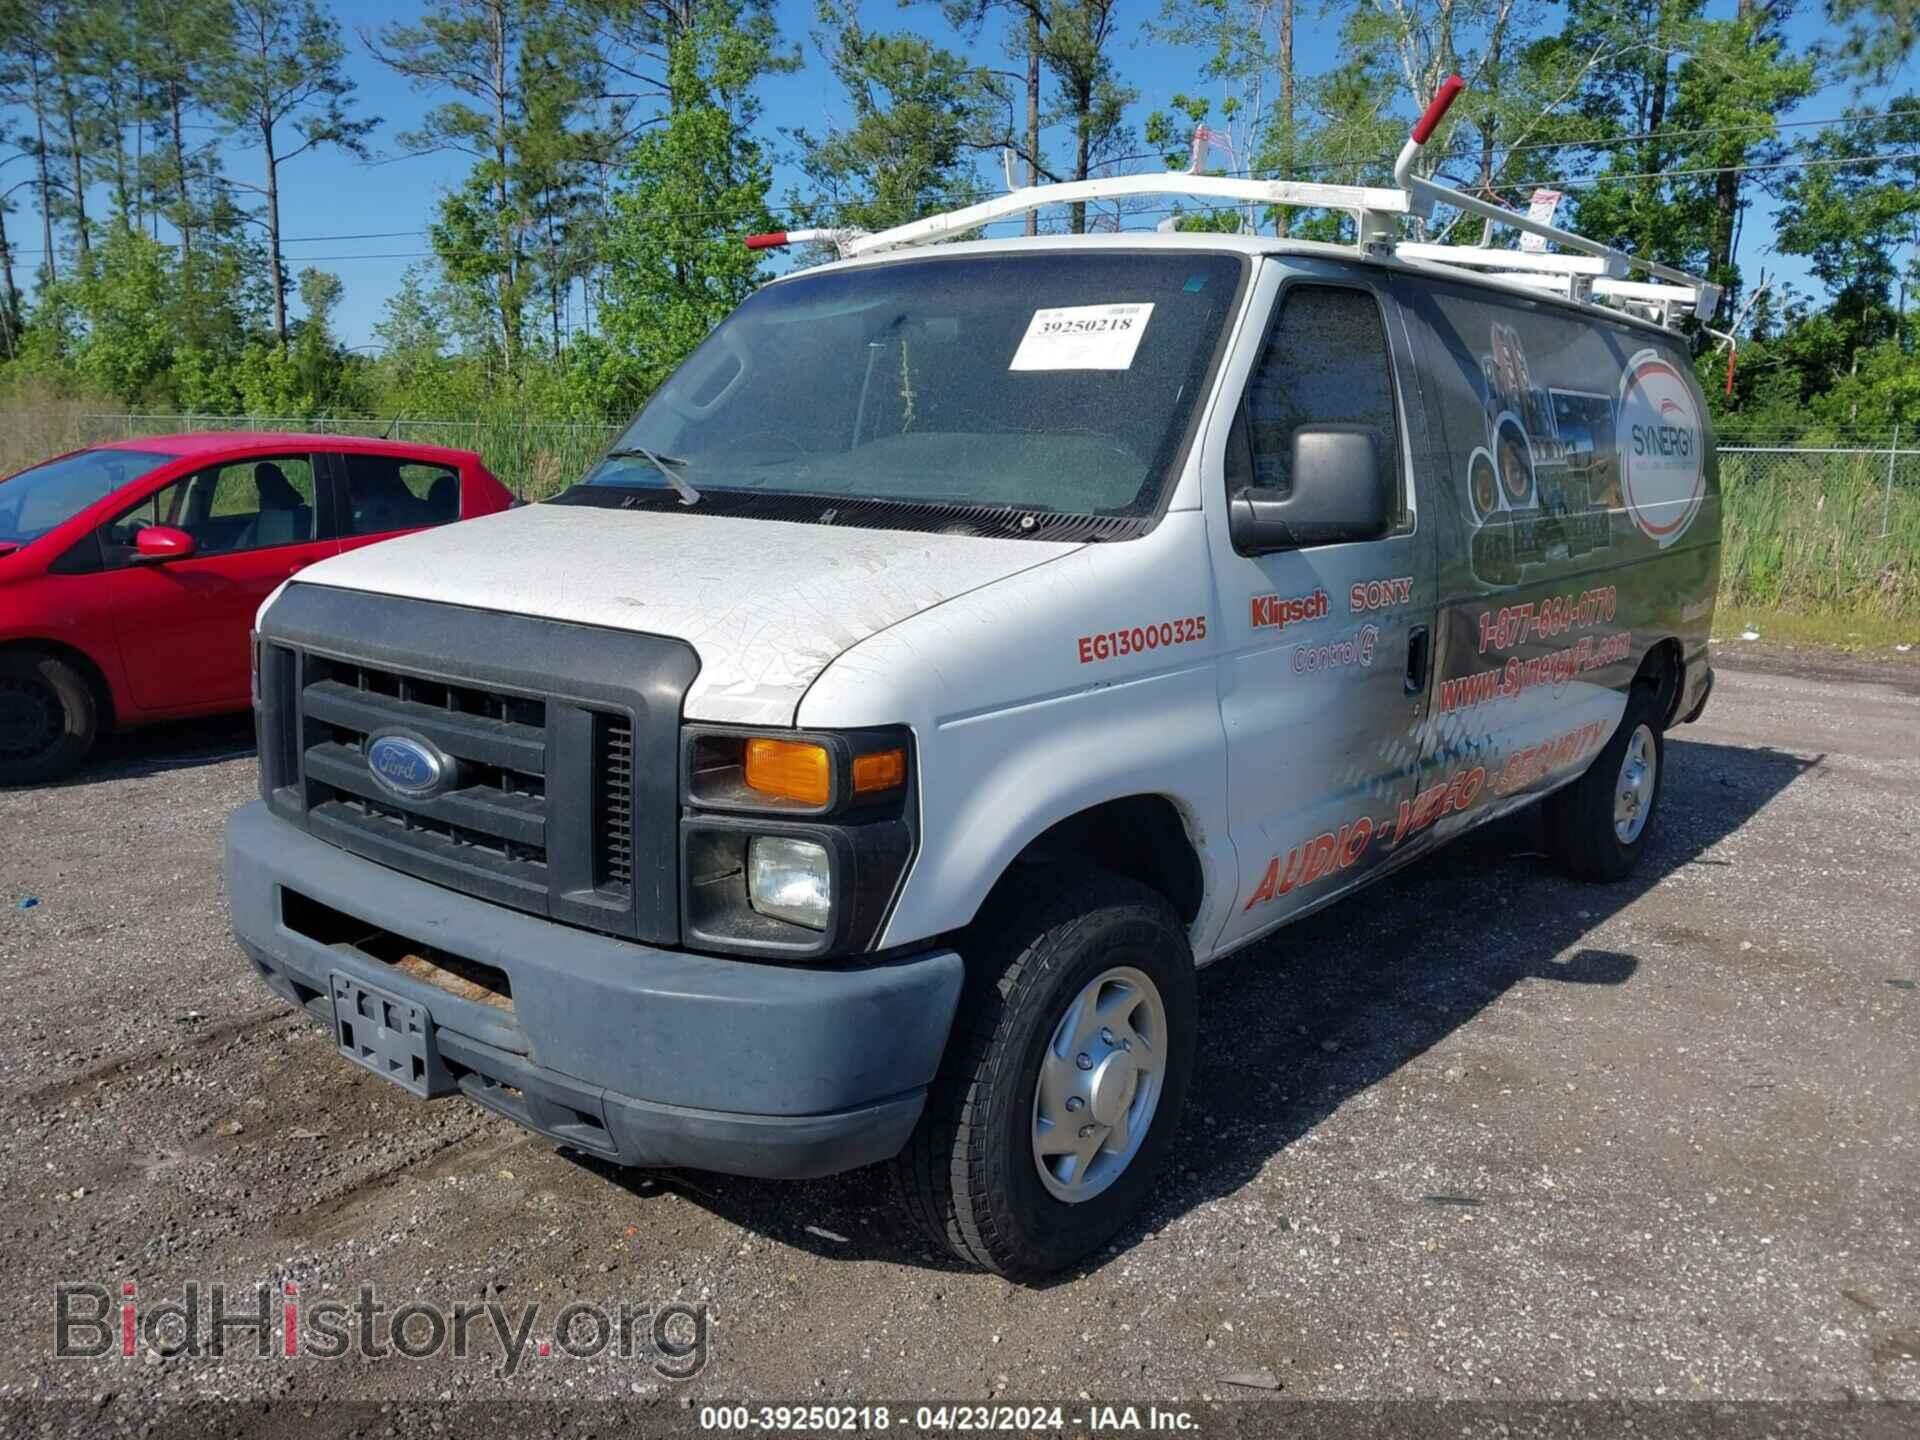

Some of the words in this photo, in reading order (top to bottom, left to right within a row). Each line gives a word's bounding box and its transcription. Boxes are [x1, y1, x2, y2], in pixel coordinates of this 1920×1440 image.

[1039, 318, 1133, 335] 39250218
[1631, 424, 1695, 457] SYNERGY
[1251, 587, 1330, 631] Klipsch
[1351, 577, 1413, 613] SONY
[1078, 616, 1207, 663] EG13000325
[379, 746, 416, 780] Ford
[1244, 816, 1374, 912] AUDIO
[1392, 766, 1487, 846] VIDEO
